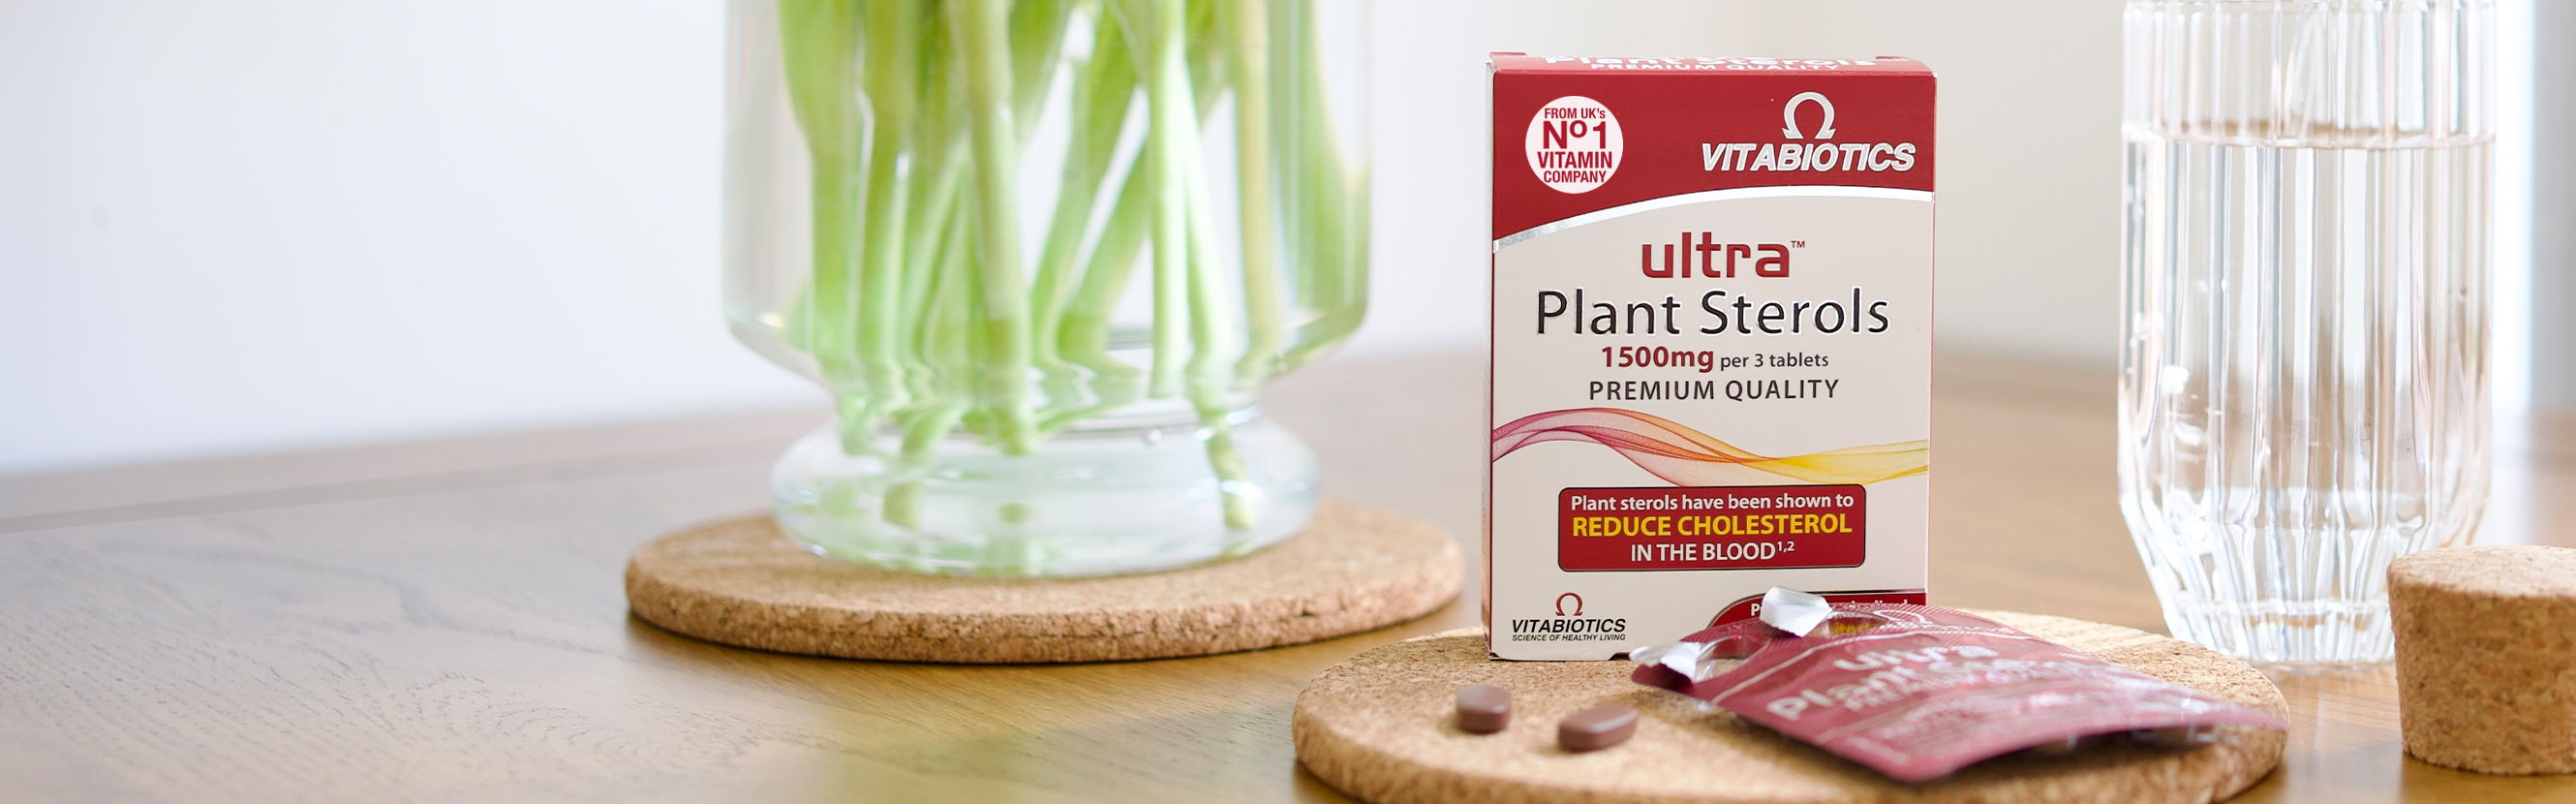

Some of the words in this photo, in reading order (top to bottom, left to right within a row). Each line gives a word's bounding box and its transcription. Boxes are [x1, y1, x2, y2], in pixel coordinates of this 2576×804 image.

[1544, 108, 1578, 119] FROM
[1580, 108, 1606, 119] UK's
[1537, 151, 1612, 169] VITAMIN
[1702, 142, 1917, 171] VITABIOTICS
[1544, 170, 1607, 183] COMPANY
[1536, 288, 1681, 335] Plant
[1701, 288, 1889, 335] Sterols
[1601, 346, 1714, 374] 1500mg
[1720, 356, 1750, 372] per
[1754, 353, 1764, 368] 3
[1768, 352, 1829, 368] tablets
[1589, 380, 1715, 401] PREMIUM
[1725, 379, 1839, 402] QUALITY
[1571, 494, 1617, 511] Plant
[1620, 494, 1678, 510] sterols
[1681, 494, 1725, 510] have
[1728, 493, 1771, 510] been
[1775, 492, 1831, 509] shown
[1835, 493, 1855, 508] to
[1573, 515, 1671, 538] REDUCE
[1677, 513, 1853, 537] CHOLESTEROL
[1631, 543, 1652, 562] IN
[1655, 542, 1698, 562] THE
[1512, 618, 1627, 634] VITABIOTICS
[1512, 634, 1548, 642] SCIENCE
